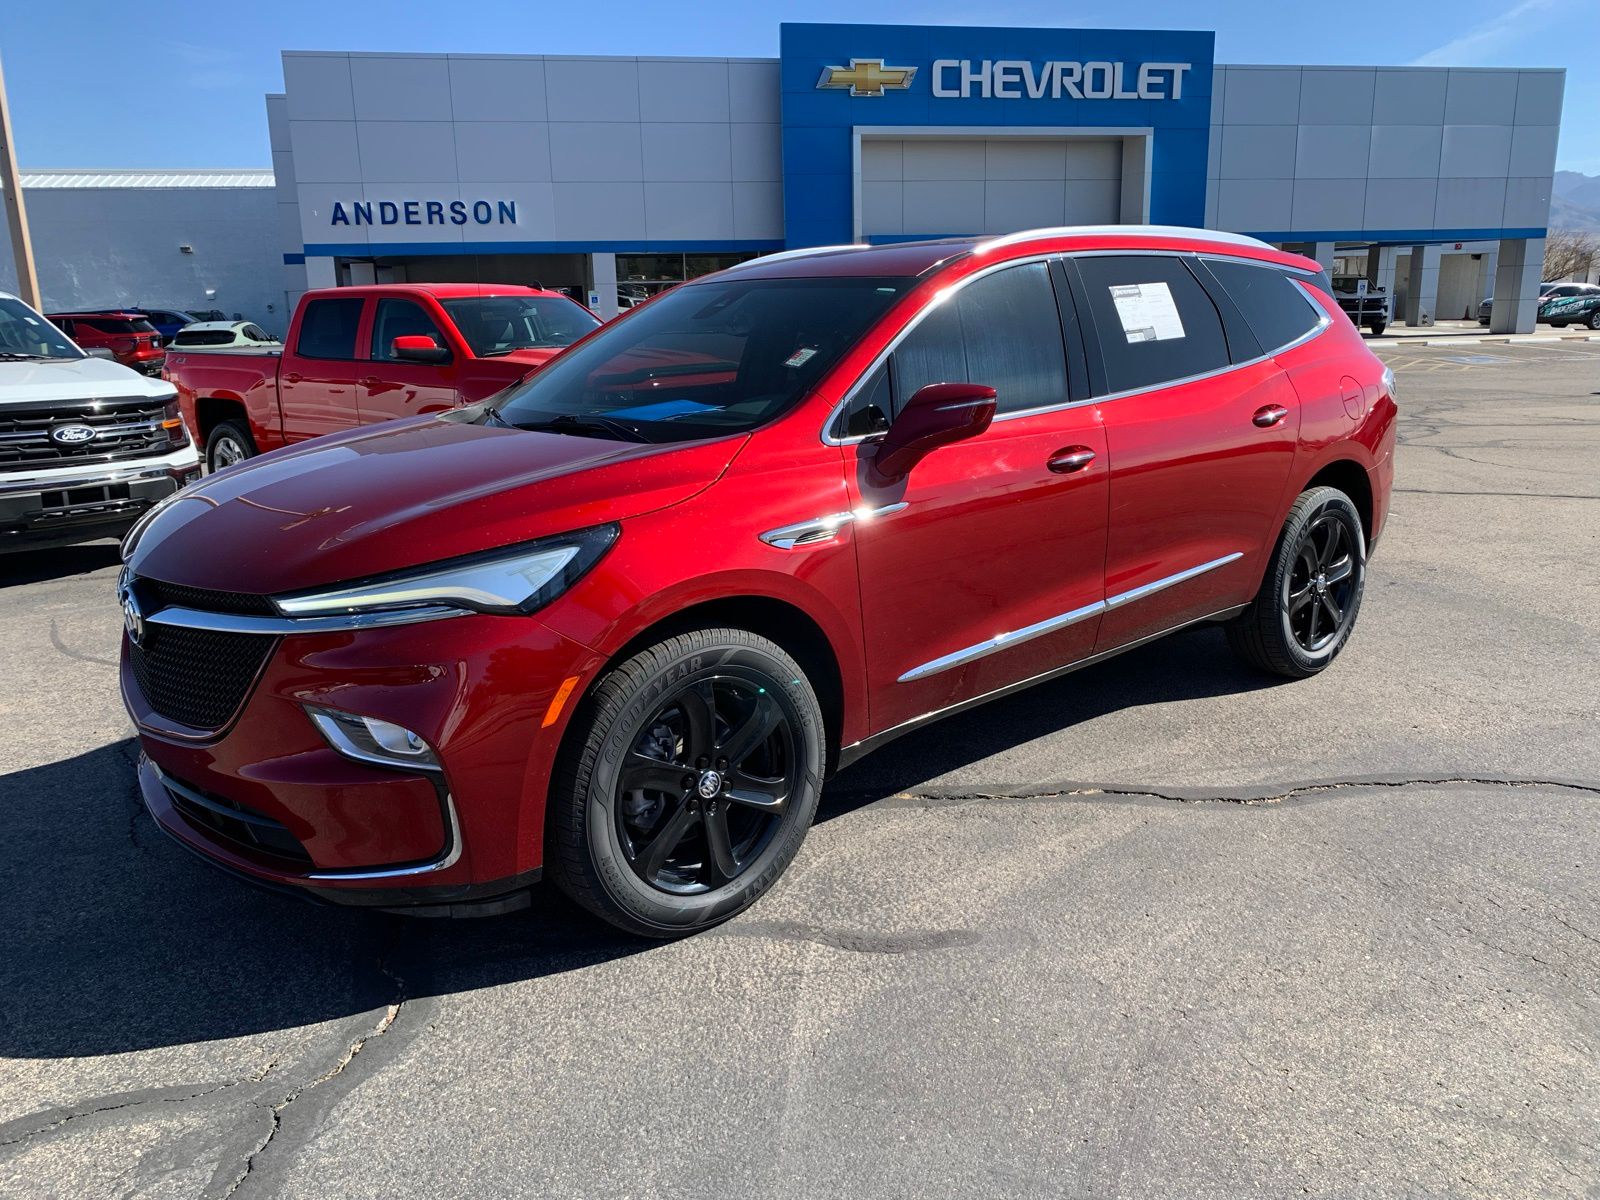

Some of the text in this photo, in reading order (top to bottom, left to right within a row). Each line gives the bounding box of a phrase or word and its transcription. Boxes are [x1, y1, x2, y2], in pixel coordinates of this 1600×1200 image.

[932, 59, 1191, 99] CHEVROLET
[331, 200, 517, 226] ANDERSON
[61, 429, 88, 440] Ford
[604, 656, 702, 765] GOODYEAR
